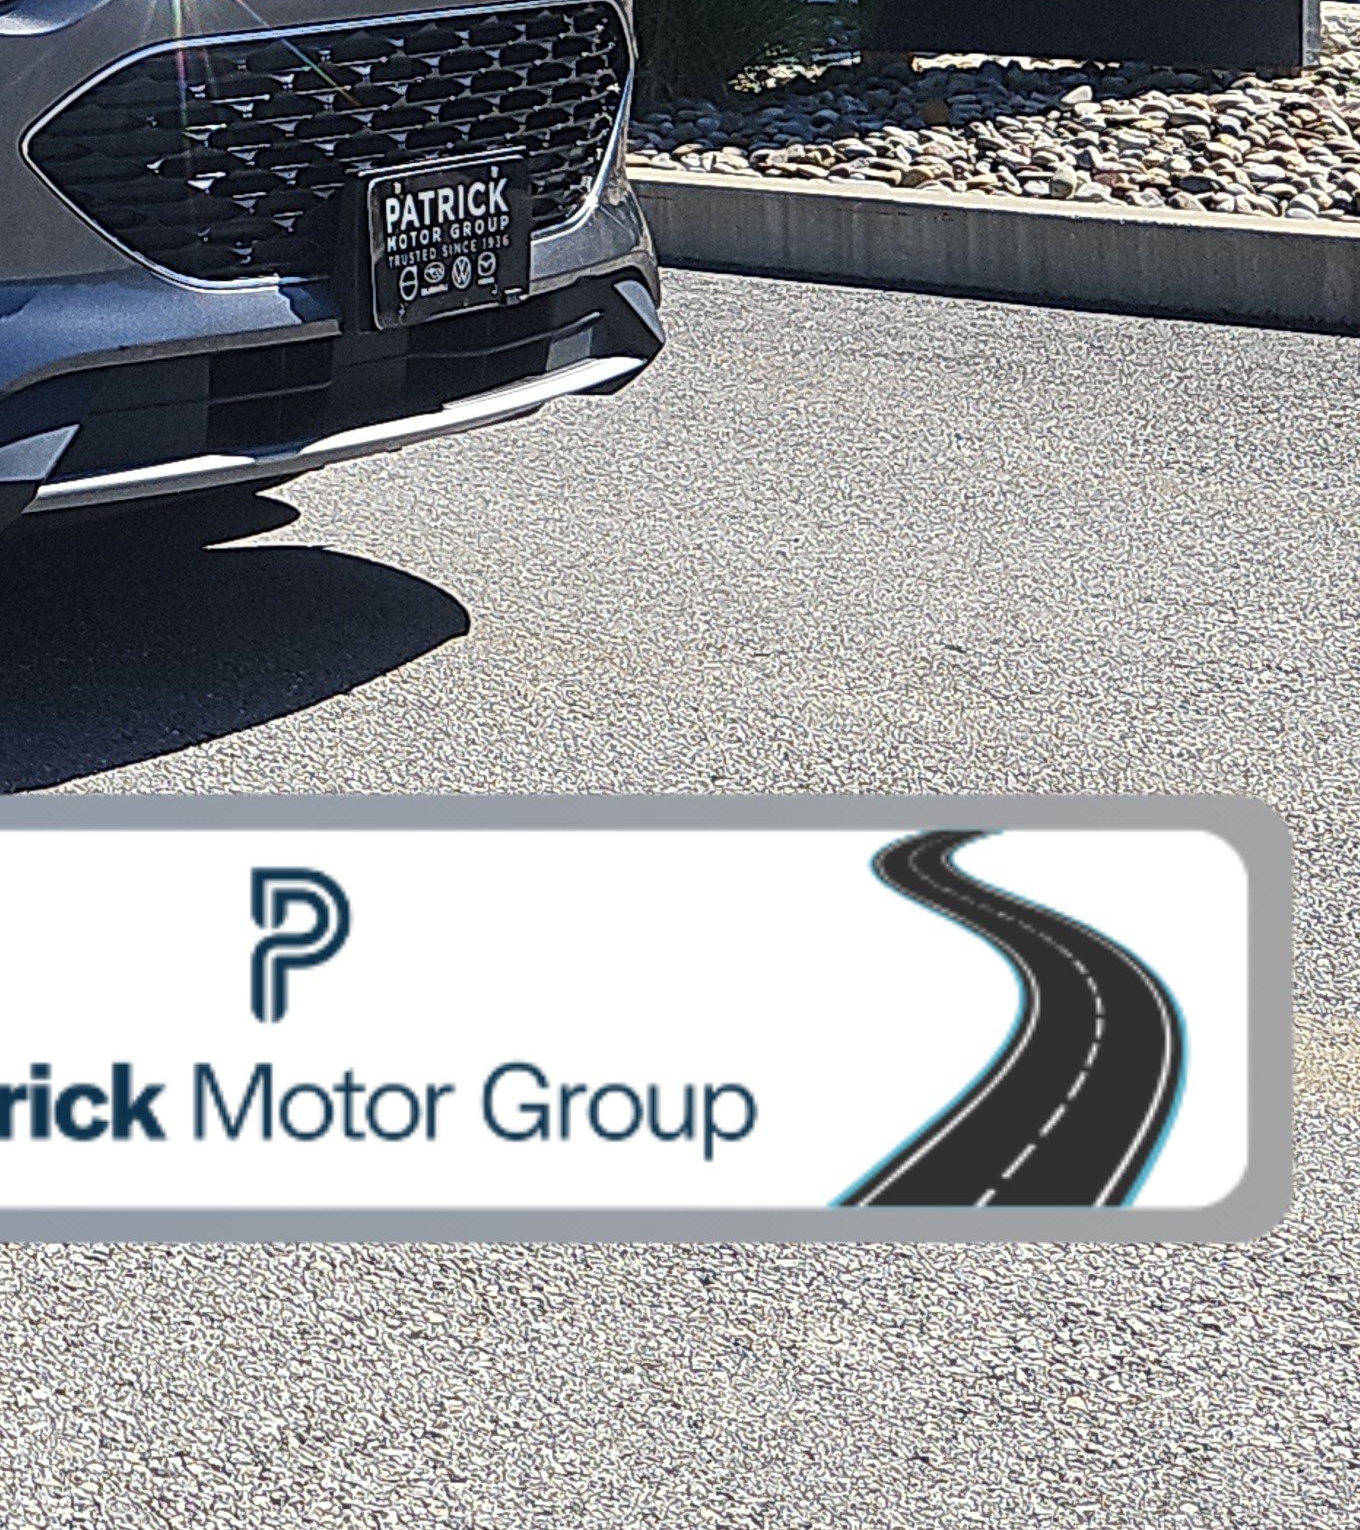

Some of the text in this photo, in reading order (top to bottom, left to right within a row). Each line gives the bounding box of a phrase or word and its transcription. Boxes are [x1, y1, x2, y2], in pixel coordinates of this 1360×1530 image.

[385, 177, 509, 234] PATRICK
[387, 215, 510, 253] MOTOR GROUP
[388, 234, 510, 268] TRUSTED SINCE 1936
